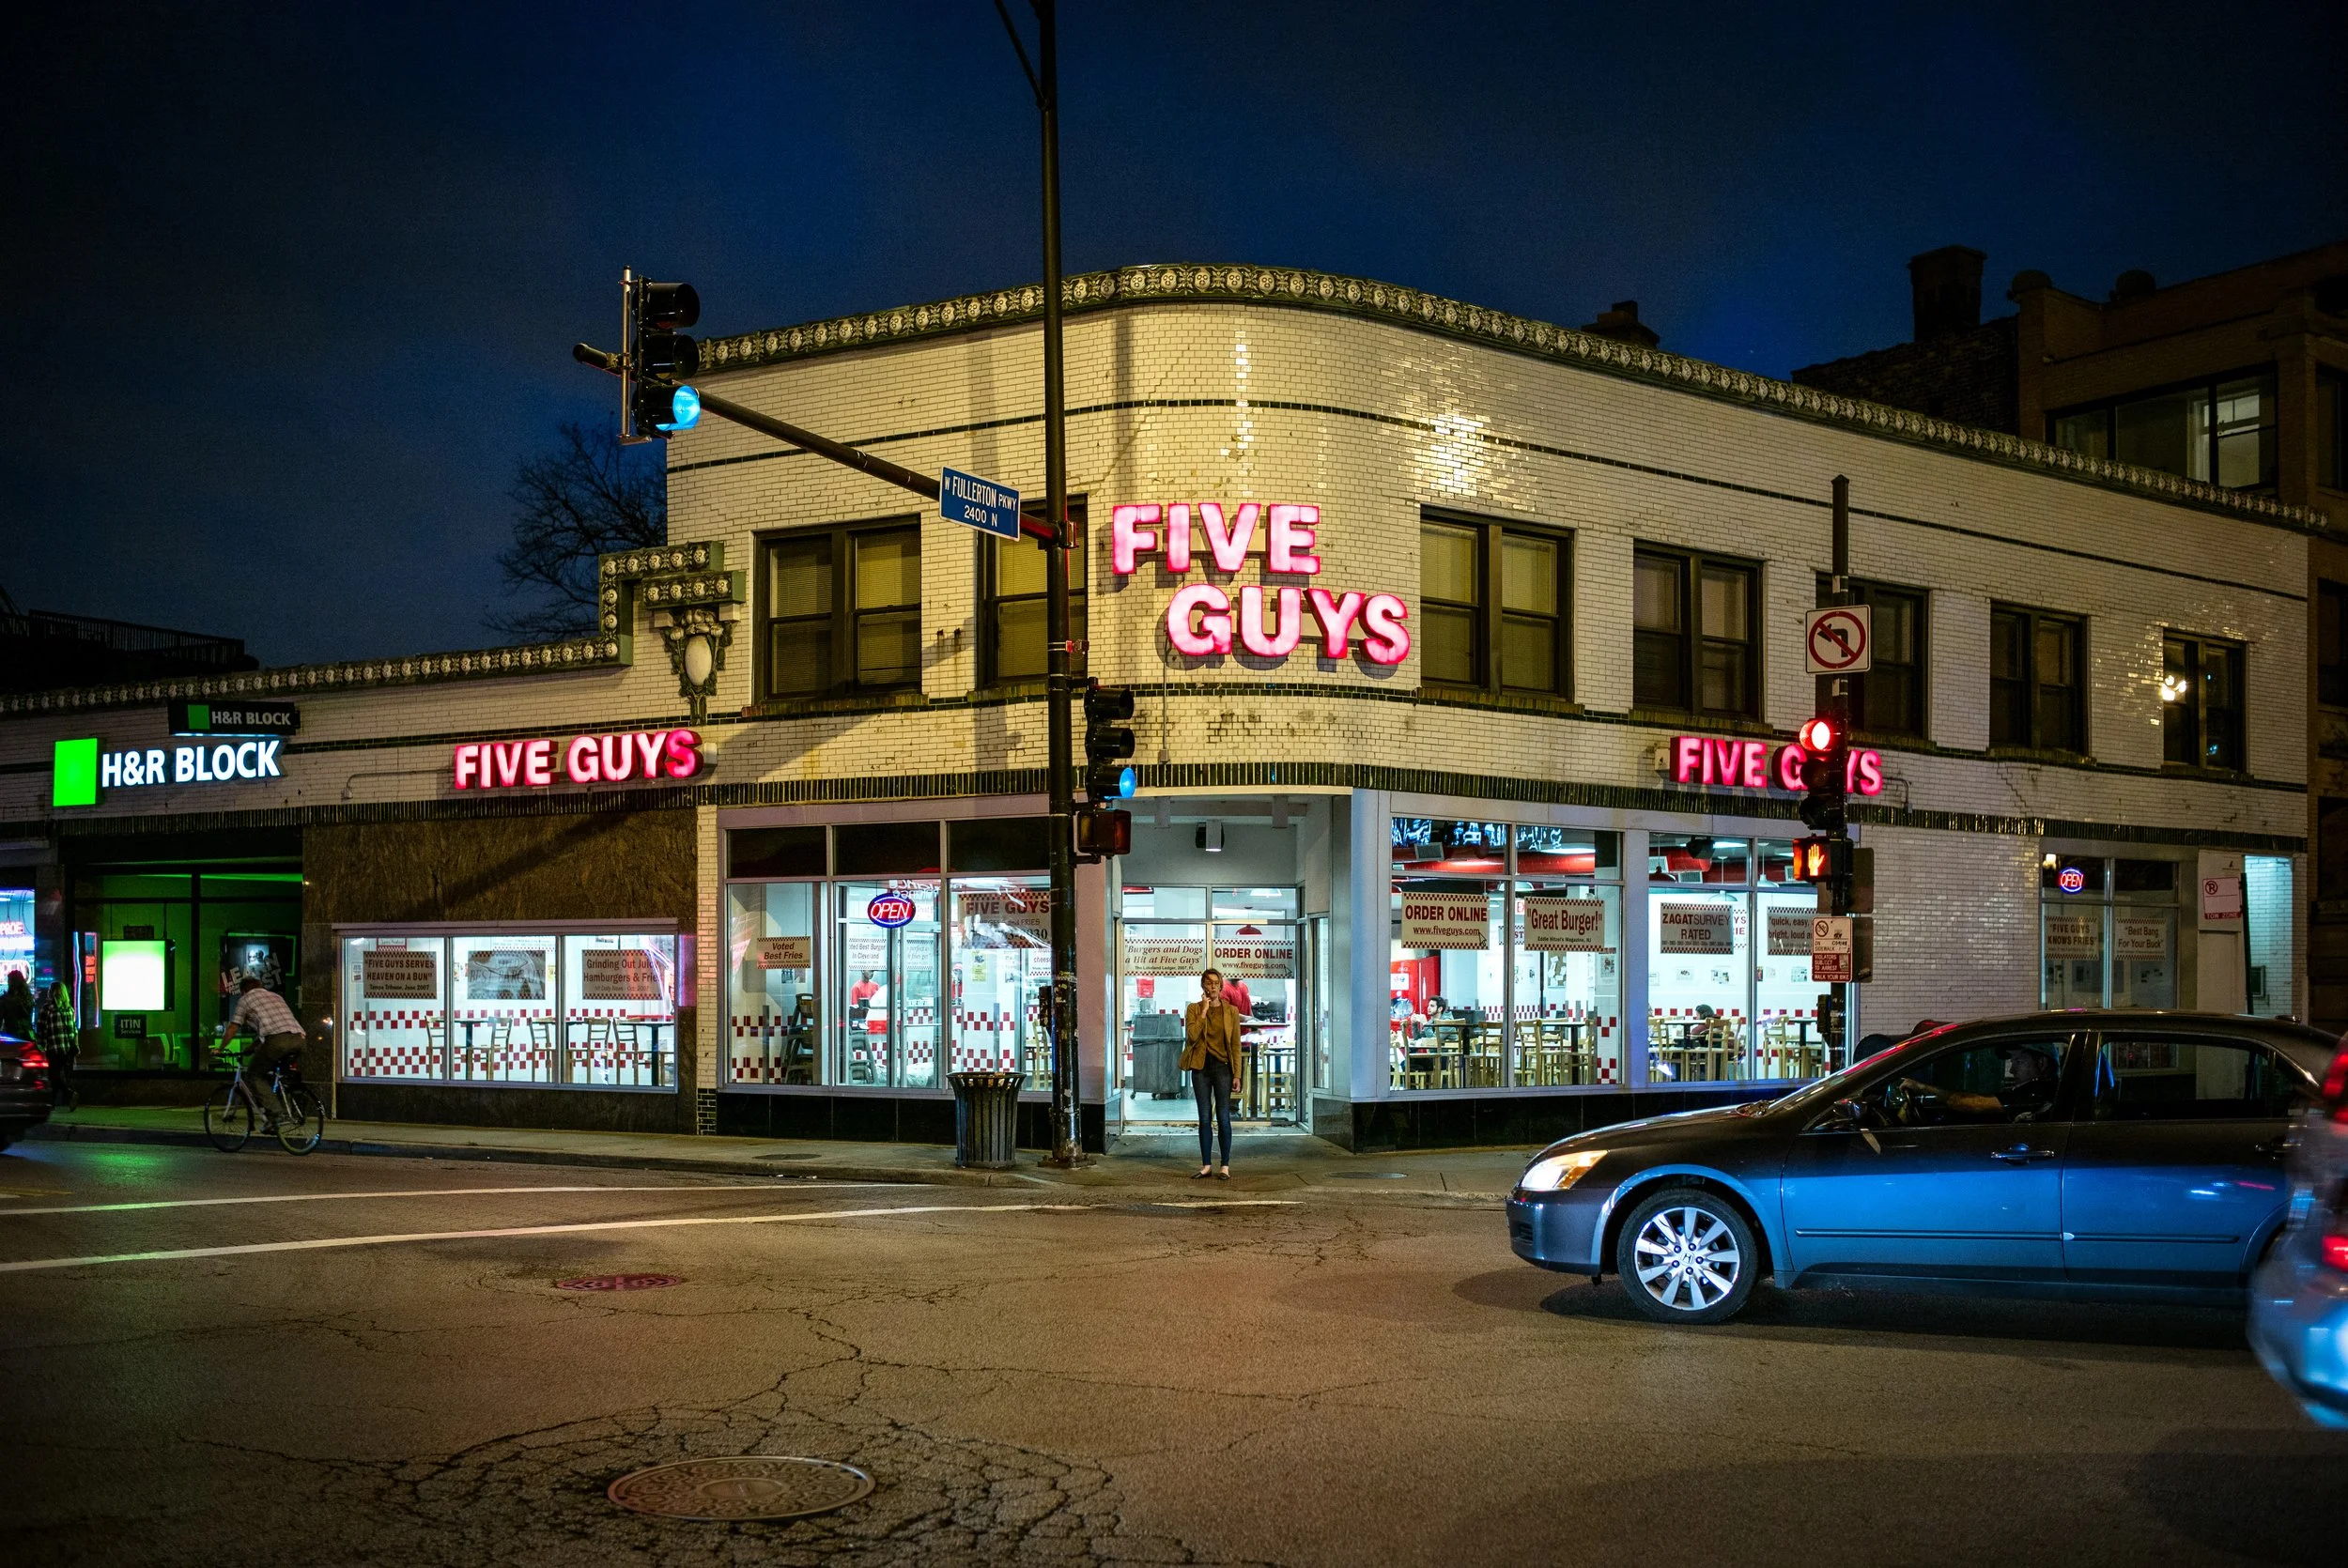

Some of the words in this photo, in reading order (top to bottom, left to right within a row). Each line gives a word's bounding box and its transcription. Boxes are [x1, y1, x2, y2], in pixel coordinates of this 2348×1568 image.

[945, 476, 950, 490] W
[952, 475, 997, 508] FULLERTON
[998, 493, 1017, 511] PKWY
[964, 505, 986, 524] 2400
[992, 513, 997, 528] N
[1112, 502, 1321, 575] FIVE
[1166, 583, 1411, 666] GUYS
[211, 711, 243, 725] H&R
[246, 712, 291, 726] BLOCK
[101, 748, 166, 788] H&R
[175, 740, 281, 783] BLOCK
[455, 739, 556, 790] FIVE
[566, 729, 703, 784] GUYS
[1675, 735, 1768, 788] FIVE
[1776, 744, 1883, 796] GYS
[2061, 873, 2084, 887] OPEN
[870, 901, 910, 919] OPEN
[965, 901, 999, 915] FIVE
[1005, 900, 1050, 915] GUYS
[1405, 904, 1444, 920] ORDER
[1448, 906, 1488, 922] ONLINE
[1527, 909, 1559, 930] "Great
[1561, 910, 1602, 935] Burger!"
[1662, 913, 1731, 926] ZAGATSURVEY
[1413, 926, 1480, 936] www.fiveguys.com
[1681, 929, 1711, 940] RATED
[1790, 930, 1805, 939] loud
[2071, 924, 2091, 933] GUYS
[2143, 928, 2159, 938] Bang
[2047, 936, 2072, 945] KNOWS
[2119, 939, 2130, 947] For
[2130, 940, 2145, 948] Your
[871, 943, 887, 952] Burger
[1125, 945, 1161, 955] "Burgers
[1163, 945, 1181, 953] and
[1182, 945, 1203, 955] Dogs
[1214, 947, 1251, 958] ORDER
[1255, 948, 1293, 960] ONLINE
[783, 951, 804, 960] Fries
[385, 960, 404, 968] GUYS
[406, 960, 434, 969] SERVES
[586, 960, 620, 971] Grinding
[622, 960, 636, 969] Out
[583, 973, 631, 984] Hamburgers
[633, 973, 639, 982] &
[642, 973, 659, 982] Frie
[120, 1019, 141, 1029] ITIN
